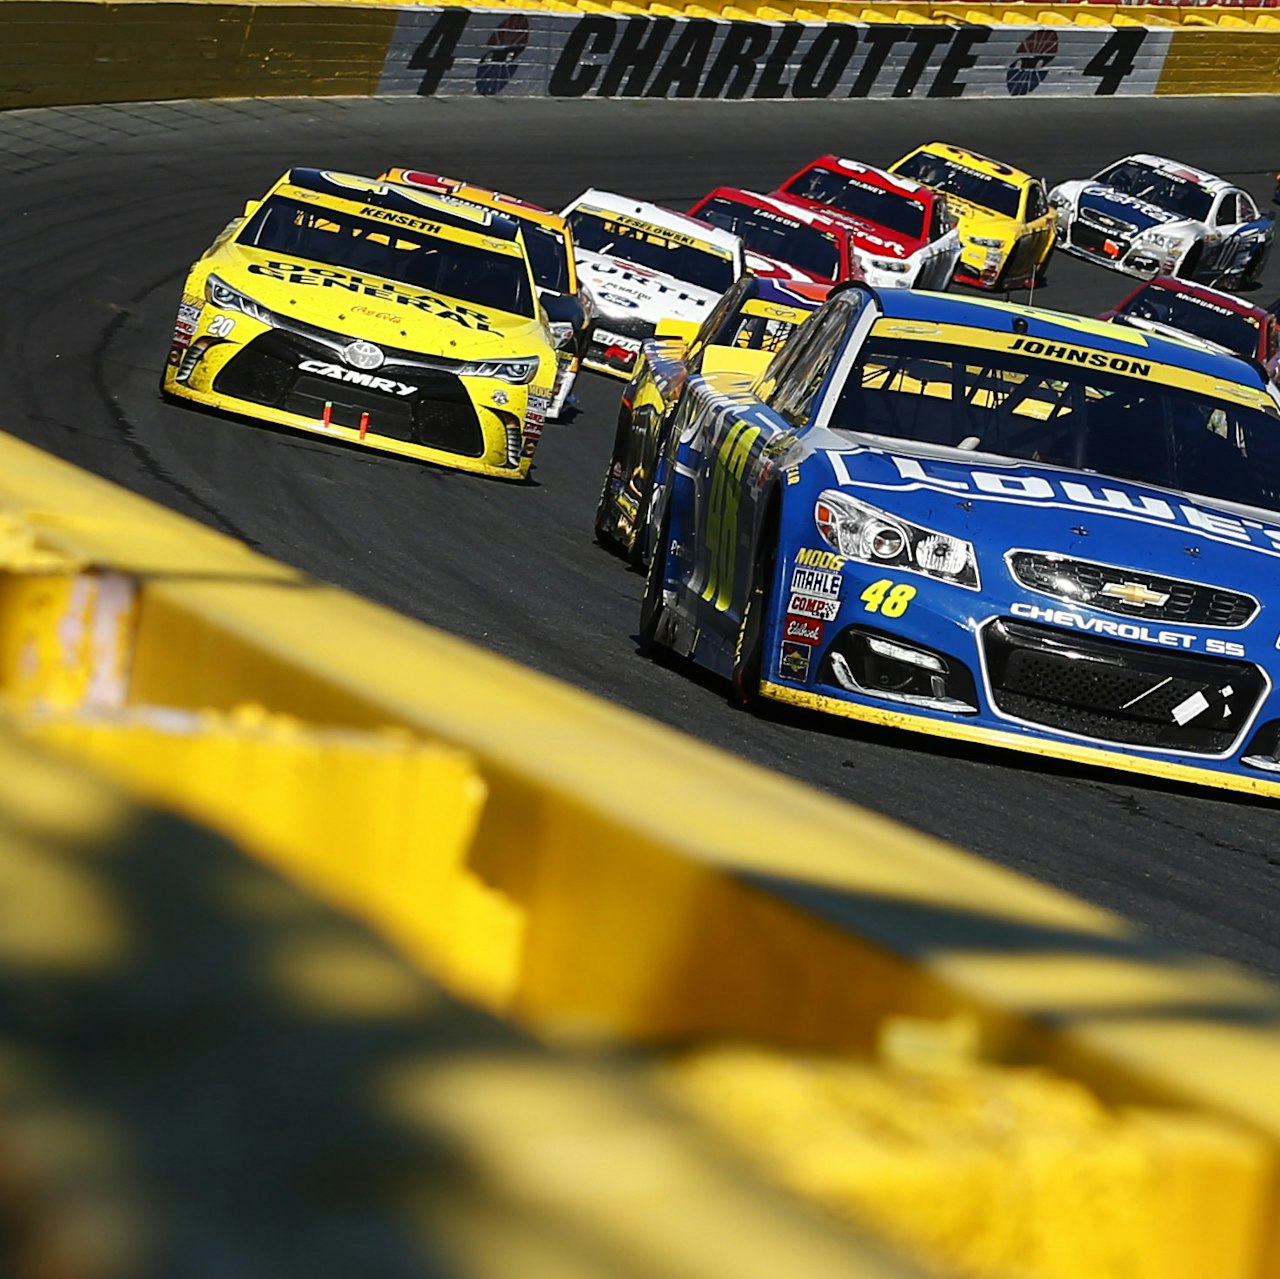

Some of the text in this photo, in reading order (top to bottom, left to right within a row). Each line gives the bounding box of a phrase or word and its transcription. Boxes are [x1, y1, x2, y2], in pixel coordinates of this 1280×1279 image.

[407, 6, 1151, 100] 4 CHARLOTTE 4
[848, 177, 887, 197] BLANEY
[1152, 168, 1187, 185] PATRICK
[359, 206, 442, 234] KENSETH
[615, 215, 696, 246] KESELOWSKI
[752, 208, 801, 230] LARSON
[247, 263, 505, 339] GENERAL
[266, 259, 492, 324] DOLLAR
[1175, 291, 1235, 318] McMURRAY
[206, 314, 236, 338] 20
[1007, 337, 1152, 377] JOHNSON
[297, 360, 420, 396] CAMRY
[794, 547, 849, 571] MOOG
[794, 569, 840, 595] MAHLE
[792, 596, 826, 613] COMP
[860, 579, 917, 618] 48
[786, 620, 820, 641] Edelbrock
[1009, 602, 1246, 658] CHEVROLET SS
